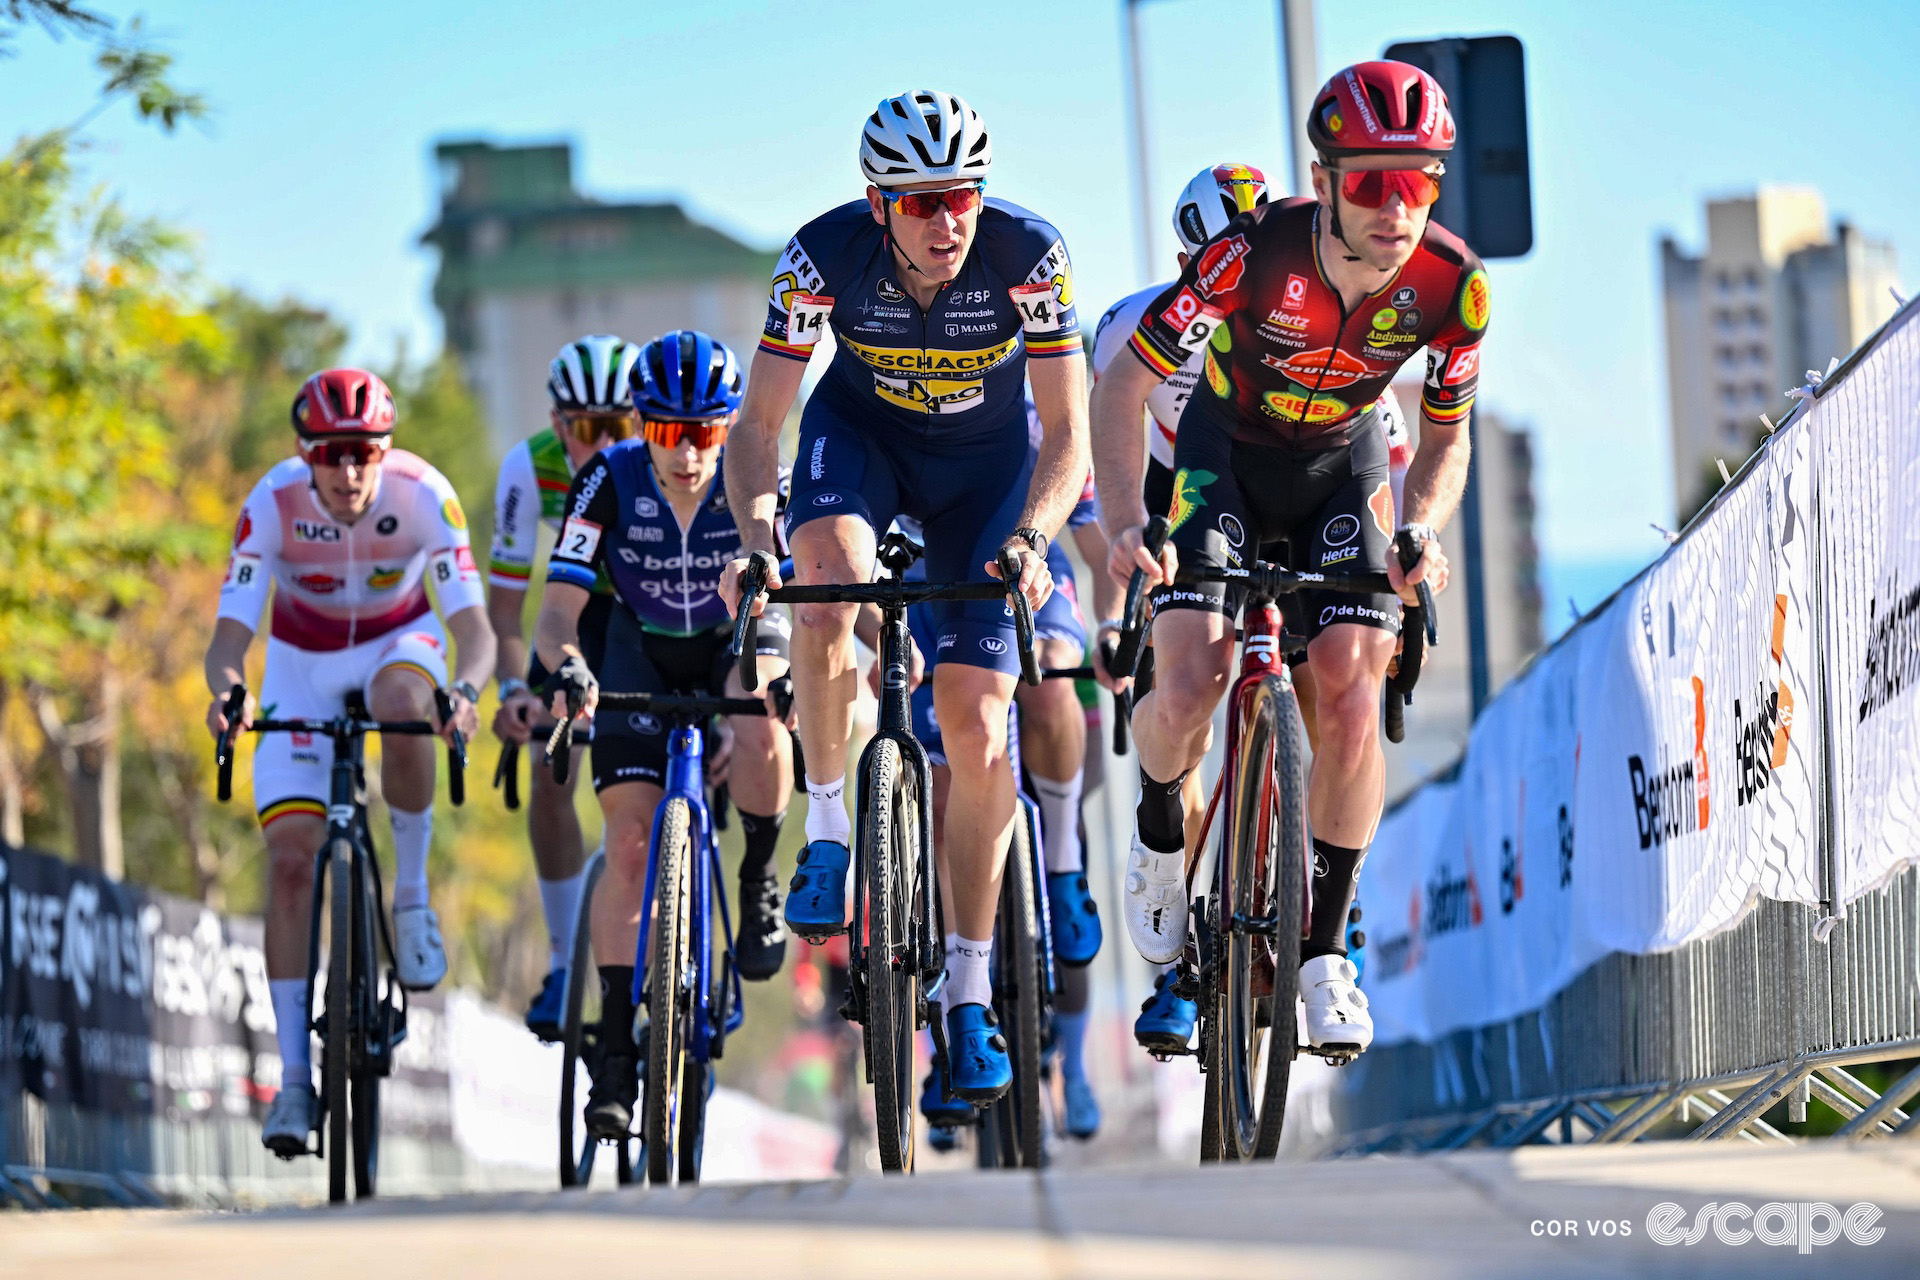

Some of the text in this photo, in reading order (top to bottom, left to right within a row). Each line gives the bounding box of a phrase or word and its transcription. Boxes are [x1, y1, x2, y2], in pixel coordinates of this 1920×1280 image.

[1350, 82, 1377, 133] CLEMENTINES
[1200, 242, 1244, 292] Pauwels
[966, 290, 990, 303] FSP
[1470, 279, 1487, 326] CIBEL
[944, 309, 995, 318] cannondale
[1020, 301, 1051, 323] 14
[1165, 312, 1186, 331] Quick
[1268, 309, 1310, 328] Hertz
[773, 320, 788, 334] FS
[796, 312, 823, 333] 14
[960, 322, 998, 333] MARIS
[1260, 323, 1308, 338] RIDLEY
[1187, 322, 1209, 346] 9
[1256, 328, 1307, 349] SHIMANO
[1366, 330, 1417, 344] Andiprim
[1362, 346, 1401, 358] STARBIKES
[1271, 396, 1339, 416] CIBEL
[811, 436, 827, 480] cannondale
[571, 534, 587, 554] 2
[1321, 546, 1359, 564] Hertz
[237, 566, 252, 585] 8
[435, 560, 451, 583] 8
[1158, 593, 1171, 605] de
[1173, 590, 1204, 603] bree
[1338, 605, 1355, 616] de
[1357, 604, 1387, 621] bree
